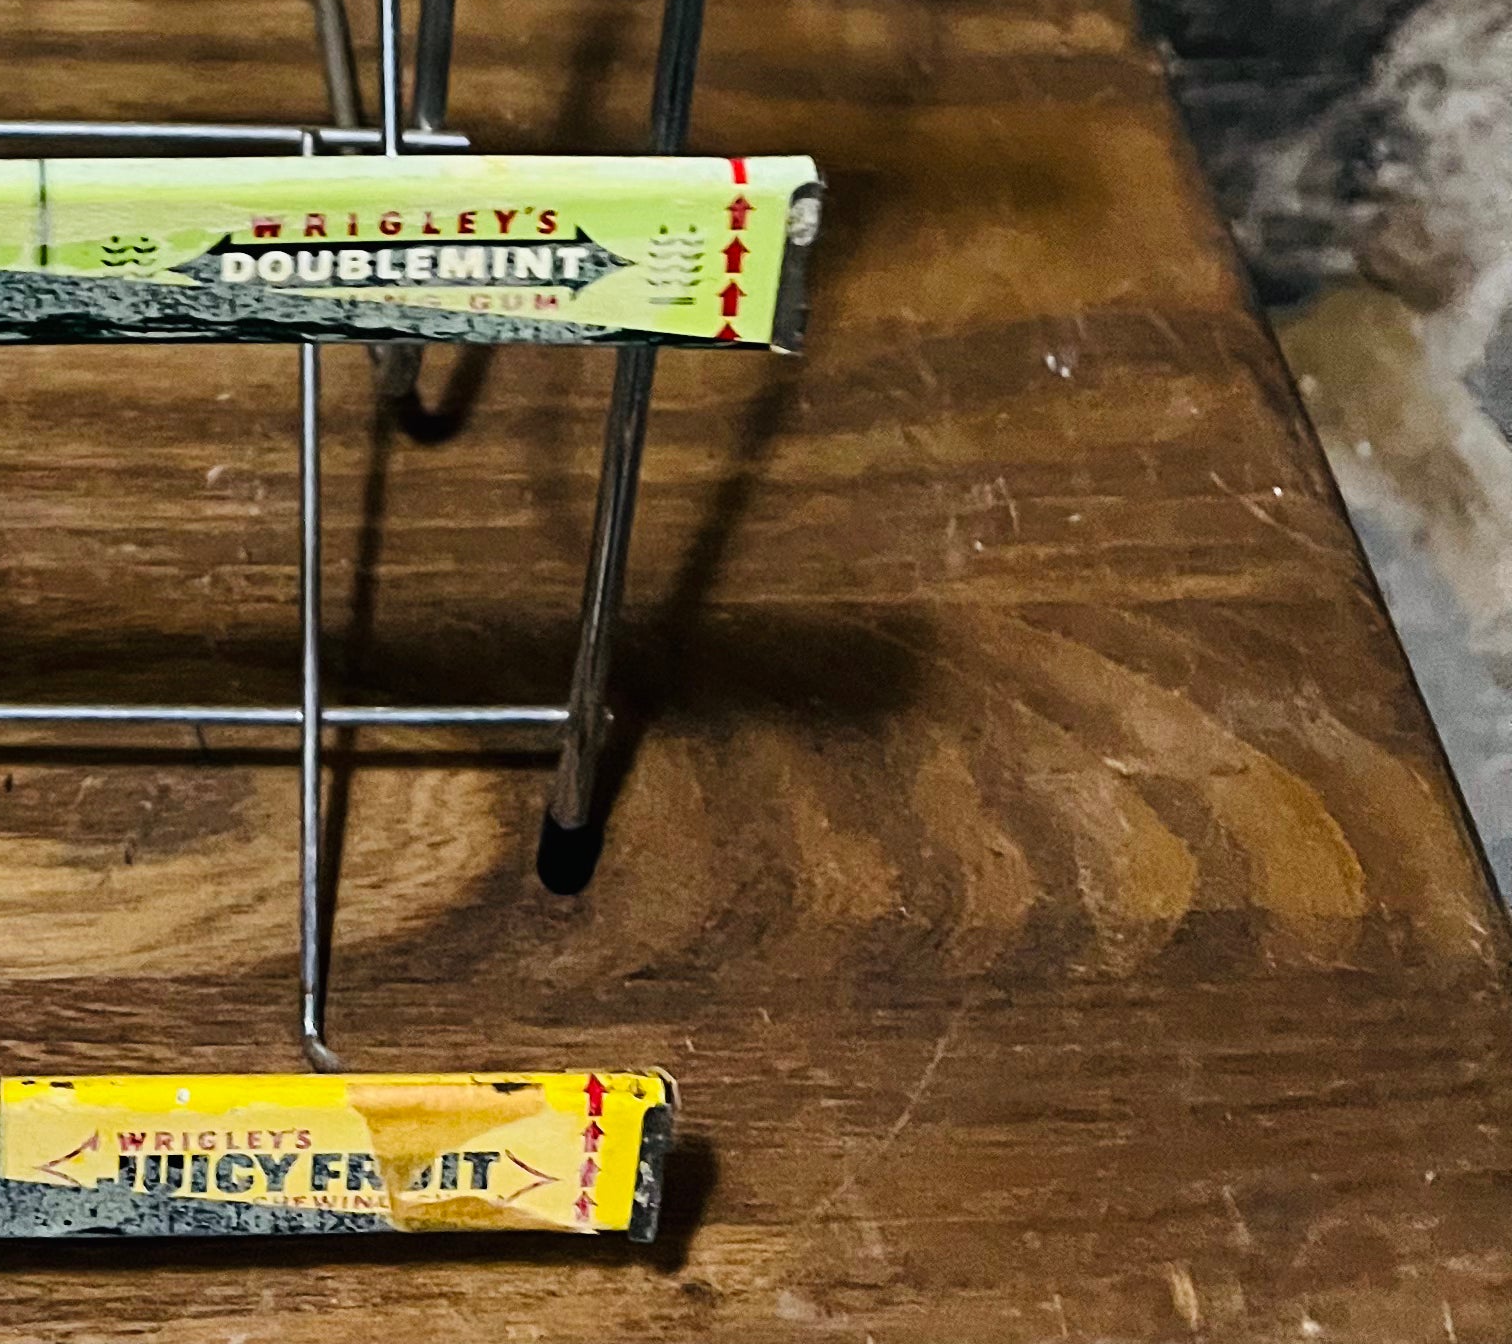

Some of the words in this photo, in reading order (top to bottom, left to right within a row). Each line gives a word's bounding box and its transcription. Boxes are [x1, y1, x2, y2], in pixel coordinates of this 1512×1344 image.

[220, 245, 589, 283] DOUBLEMINT
[118, 1129, 313, 1151] WRIGLEY'S
[96, 1152, 299, 1195] JUICY
[310, 1151, 500, 1192] FRIT
